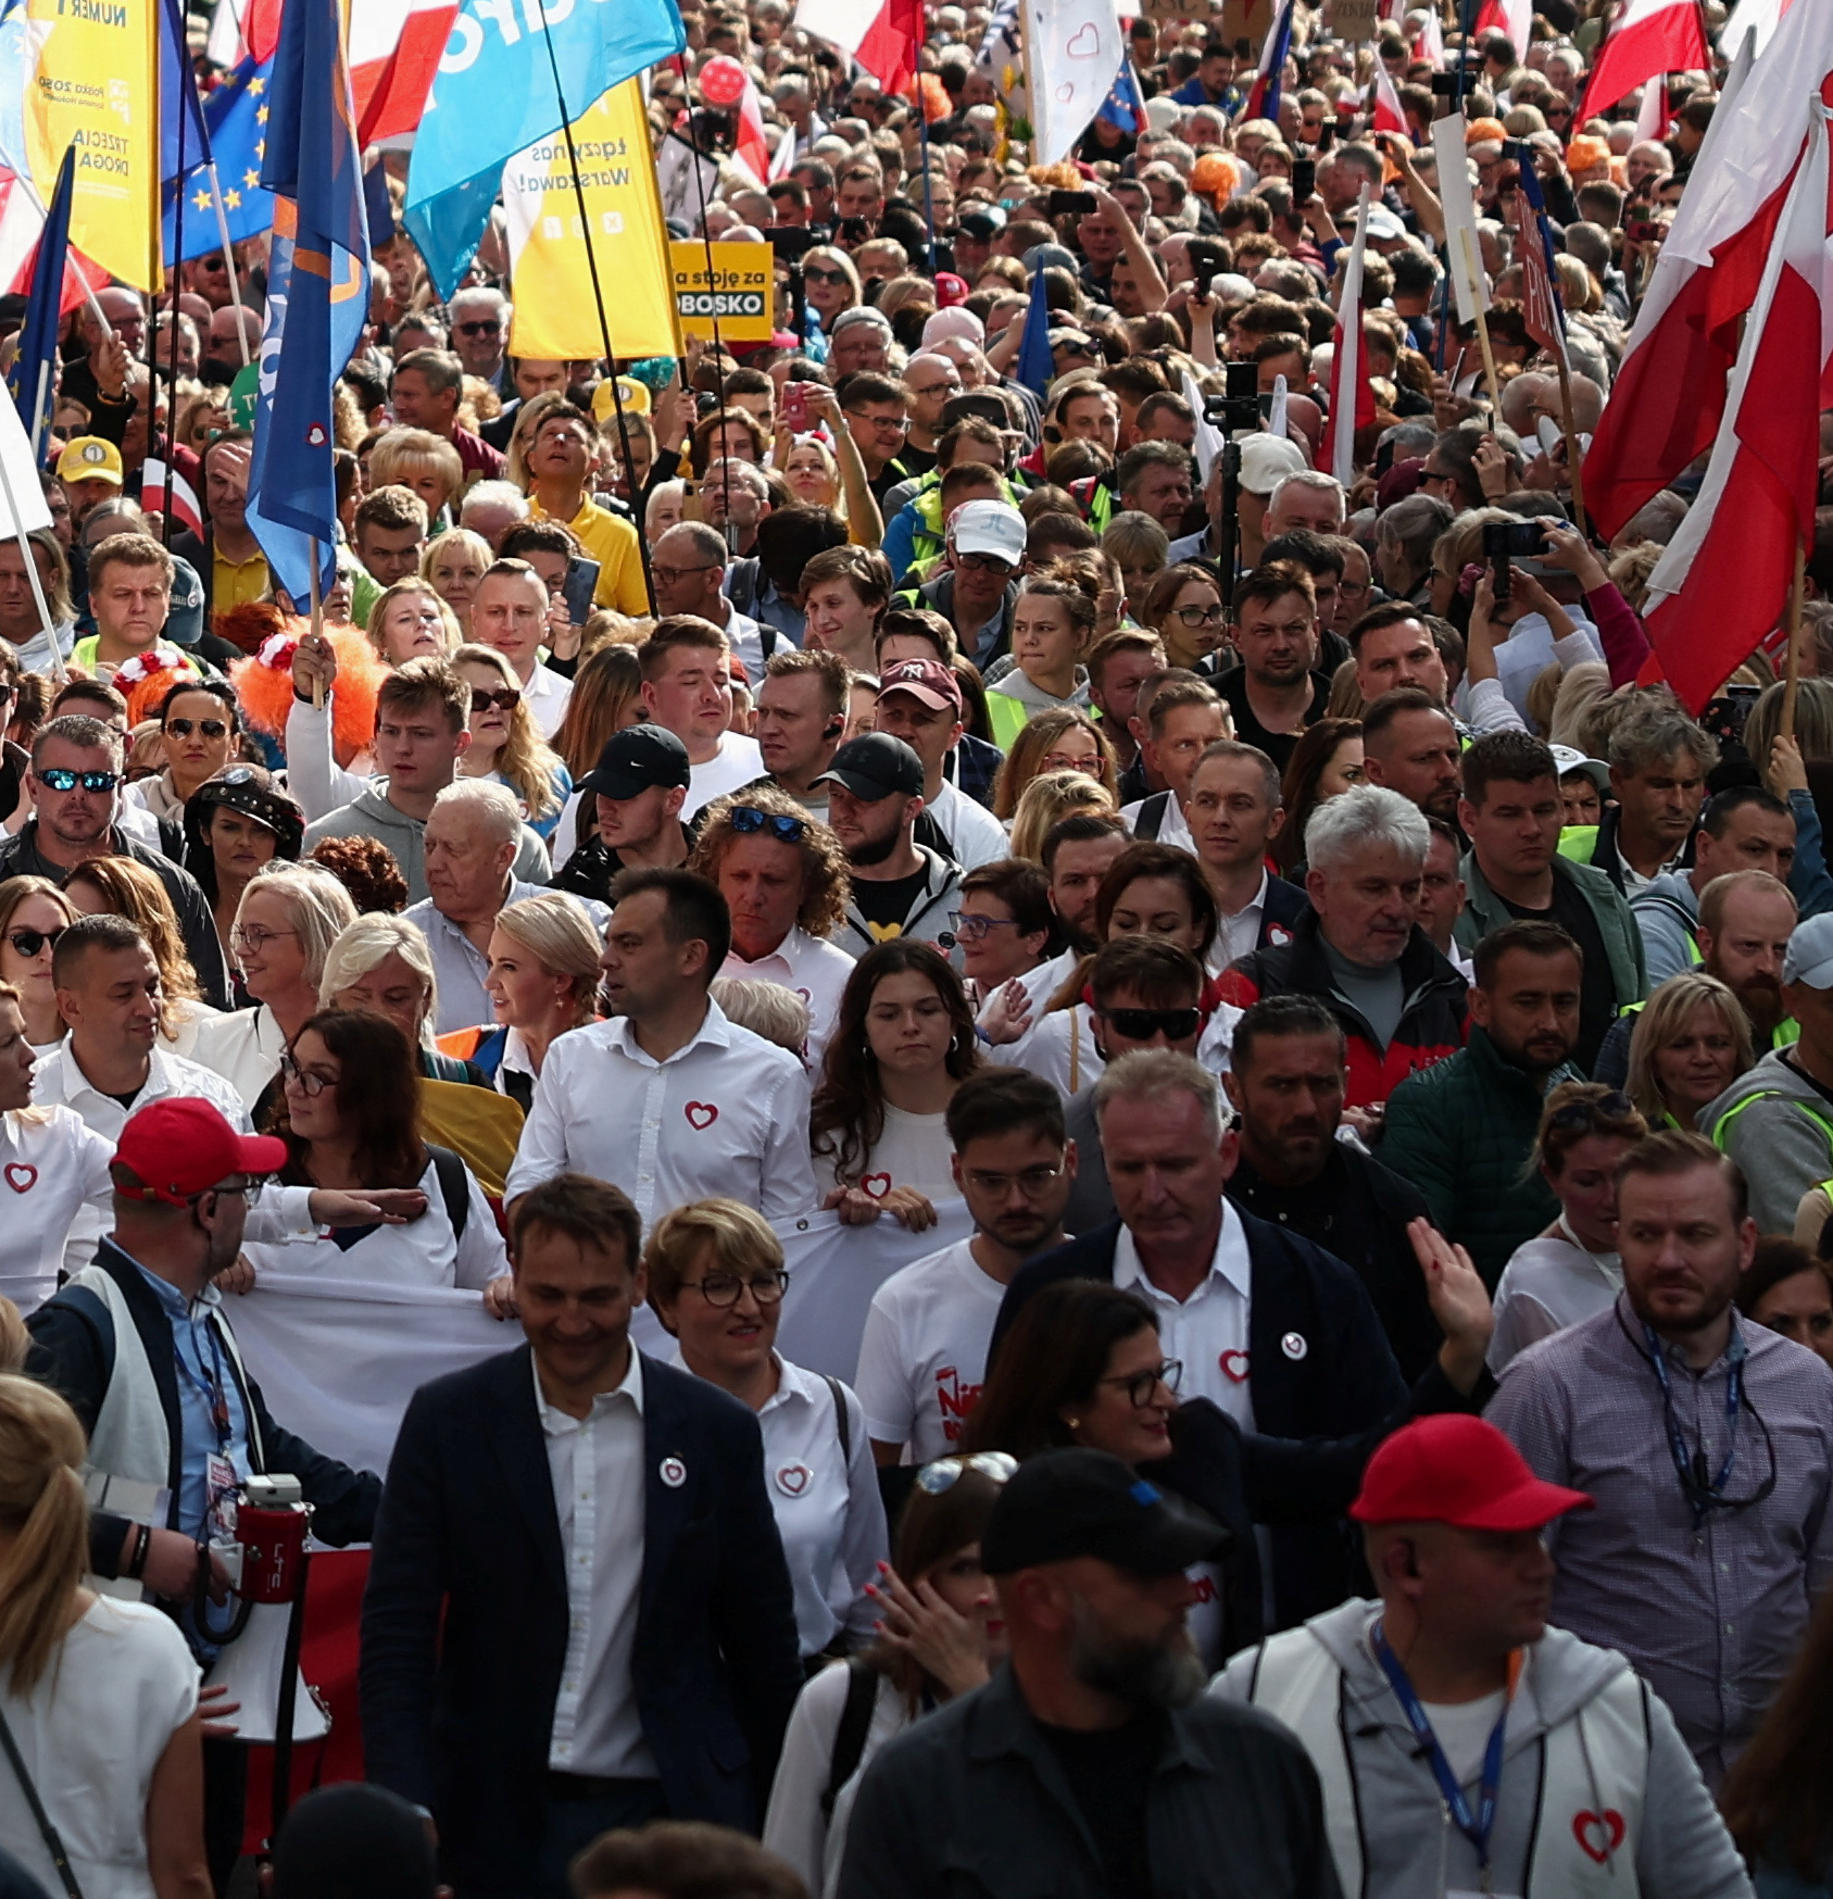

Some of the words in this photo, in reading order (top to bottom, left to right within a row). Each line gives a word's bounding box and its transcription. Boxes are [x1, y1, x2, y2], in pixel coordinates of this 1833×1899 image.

[674, 269, 688, 285] a
[692, 269, 739, 289] stoję
[744, 272, 766, 285] za
[678, 294, 762, 314] BOSKO
